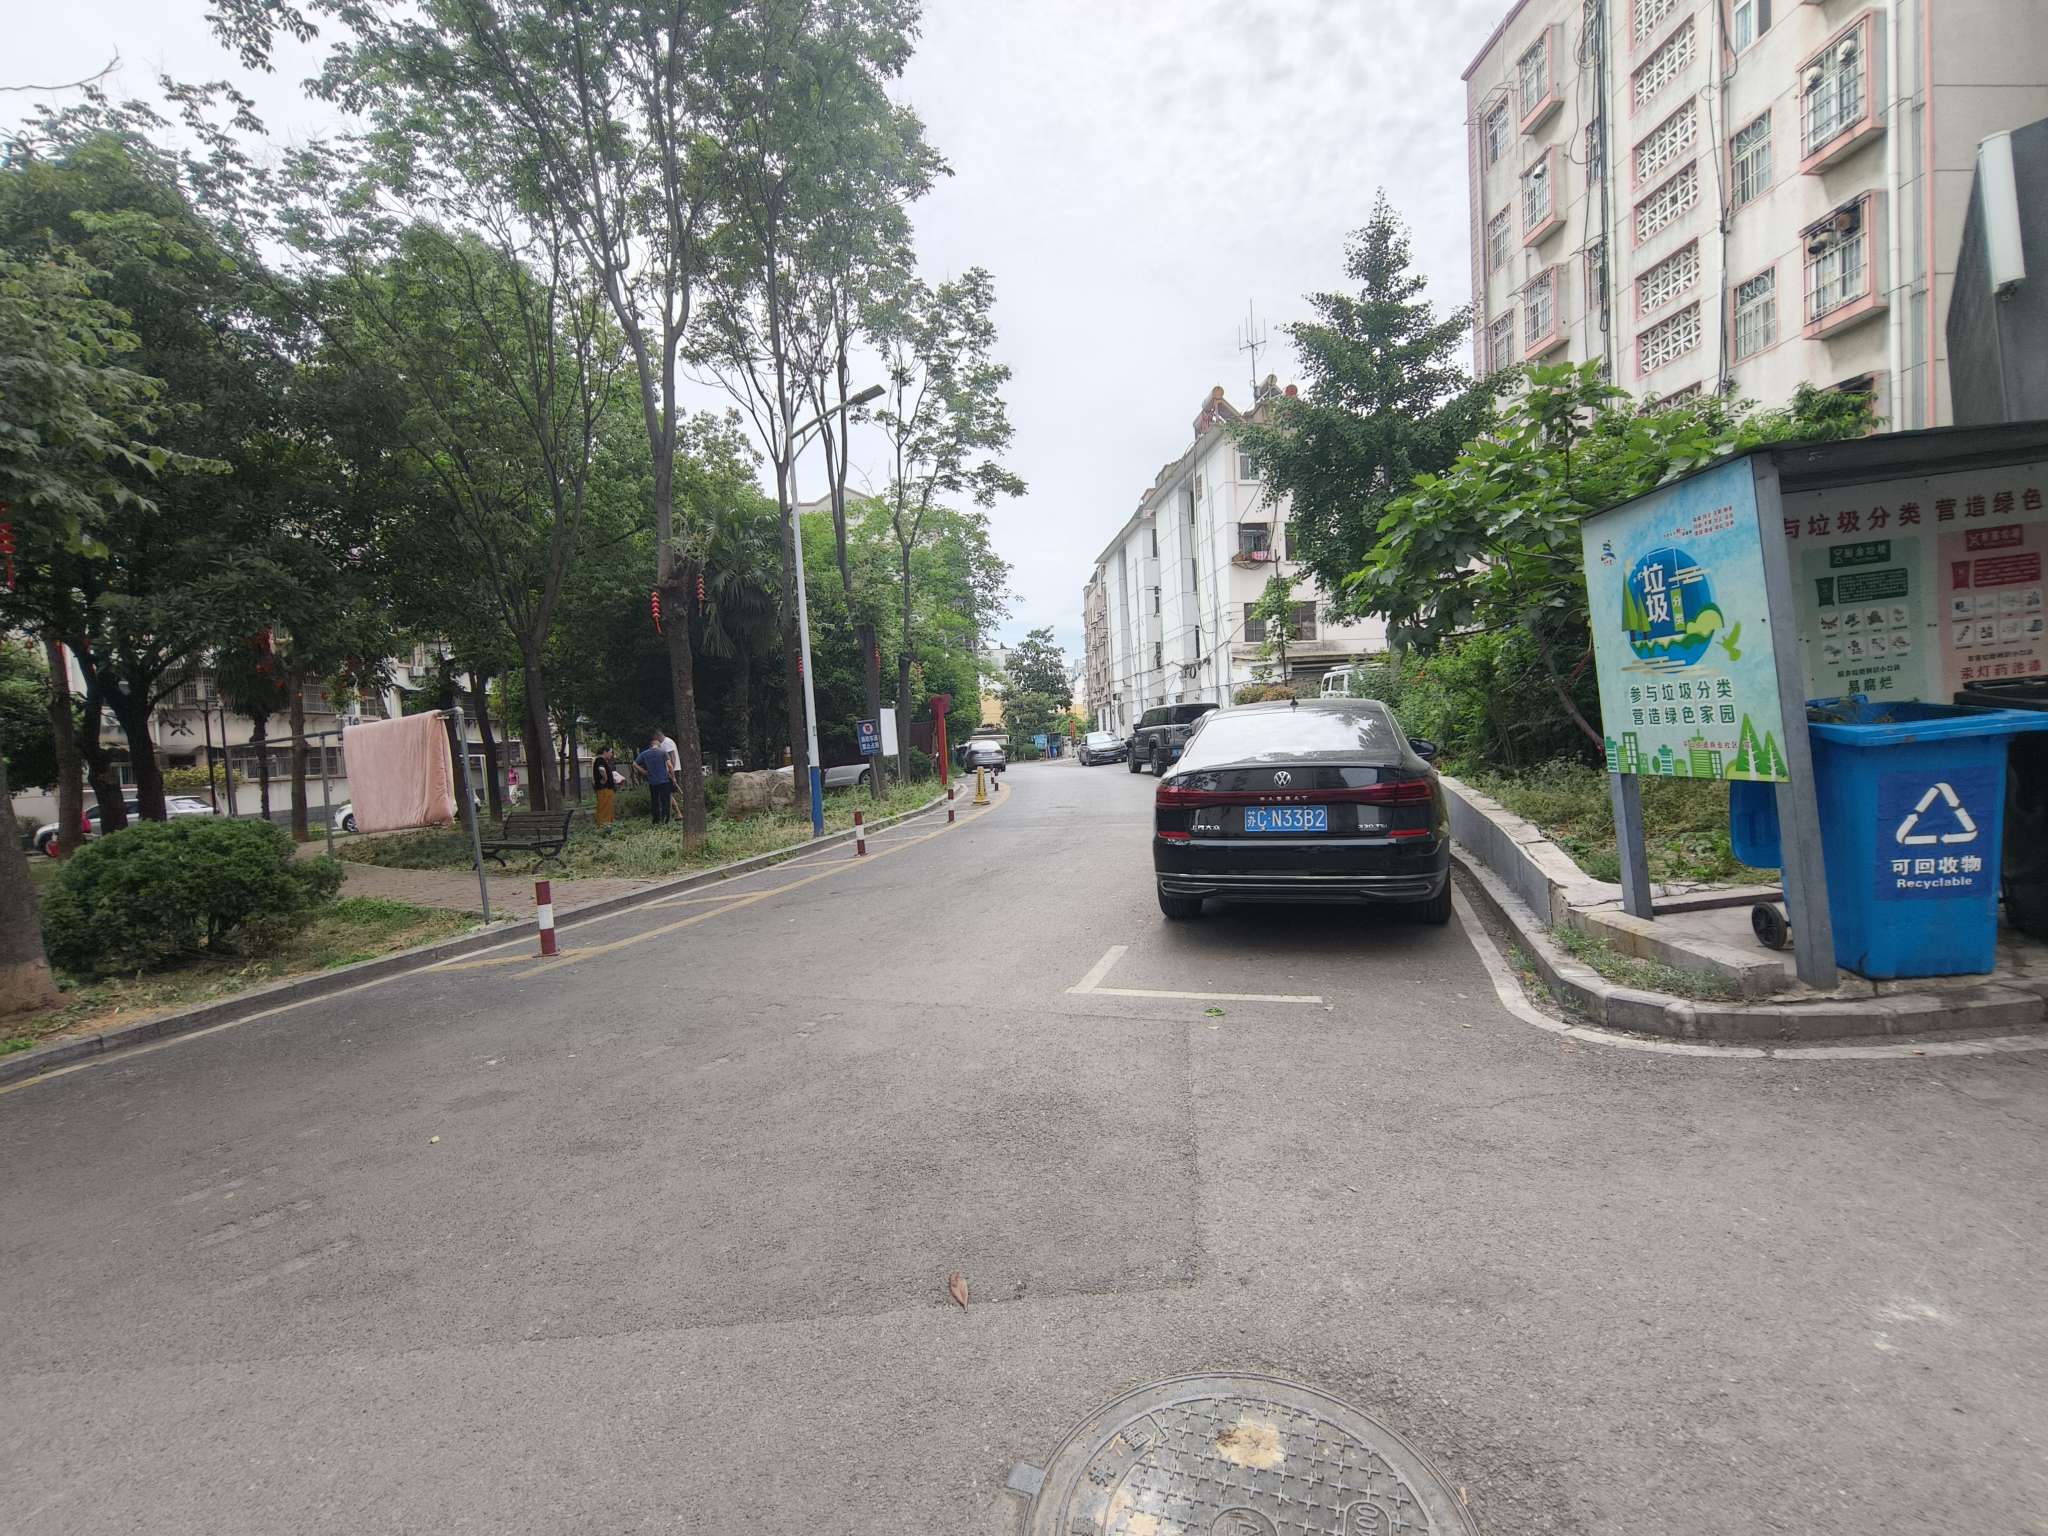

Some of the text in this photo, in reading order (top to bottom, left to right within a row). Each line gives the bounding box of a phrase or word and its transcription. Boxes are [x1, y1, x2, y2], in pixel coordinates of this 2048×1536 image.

[1936, 487, 2043, 522] 营造绿色
[1643, 563, 1670, 623] 垃圾
[1629, 678, 1733, 704] 参与垃圾分类
[1848, 676, 1894, 693] 易腐烂
[1631, 704, 1736, 726] 营造绿色家园
[1891, 855, 1982, 876] 可回收物
[1896, 877, 1973, 890] Recyclable
